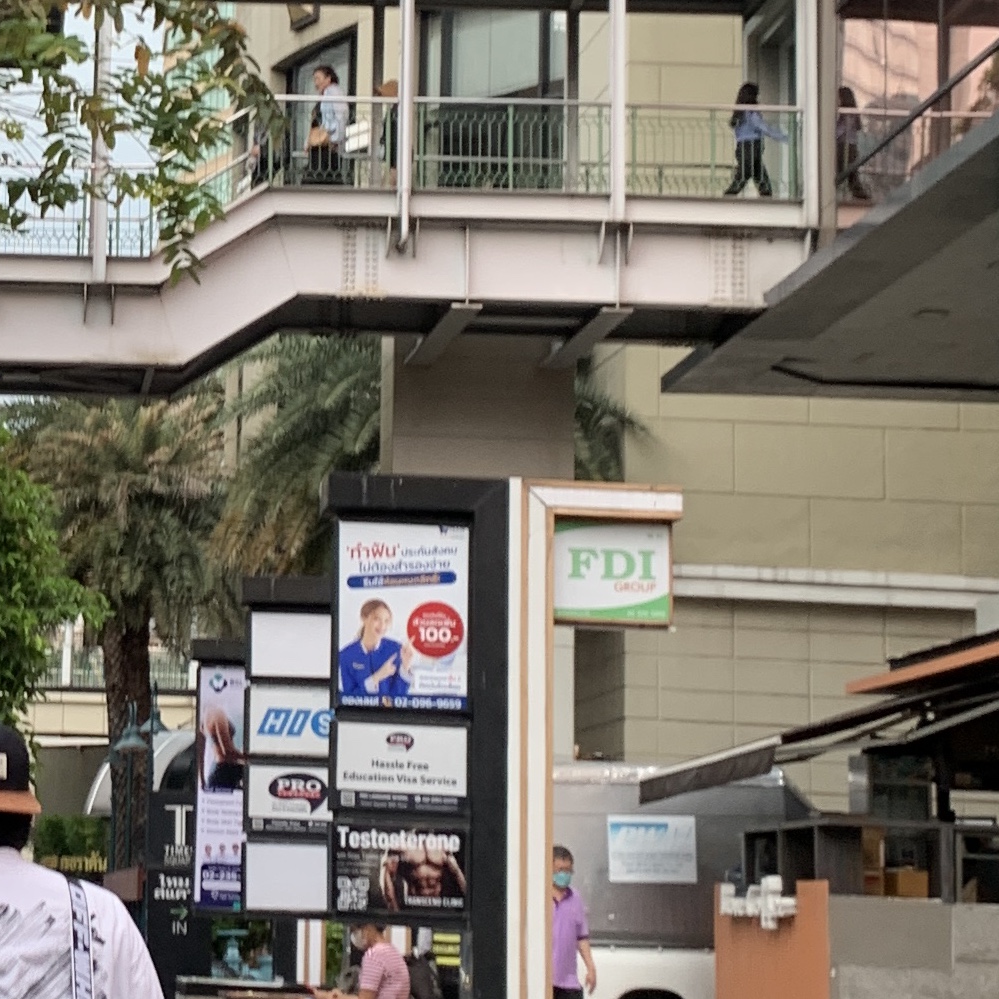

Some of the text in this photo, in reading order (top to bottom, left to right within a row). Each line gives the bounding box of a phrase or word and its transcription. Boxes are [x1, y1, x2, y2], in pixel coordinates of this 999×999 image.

[568, 547, 656, 579] FDI
[614, 581, 656, 593] GROUP
[257, 708, 335, 738] HIS
[371, 759, 429, 771] Hassle Free
[277, 778, 322, 792] PRO
[343, 770, 457, 786] Education Visa Service
[337, 825, 460, 853] Testosterone
[172, 920, 187, 935] IN
